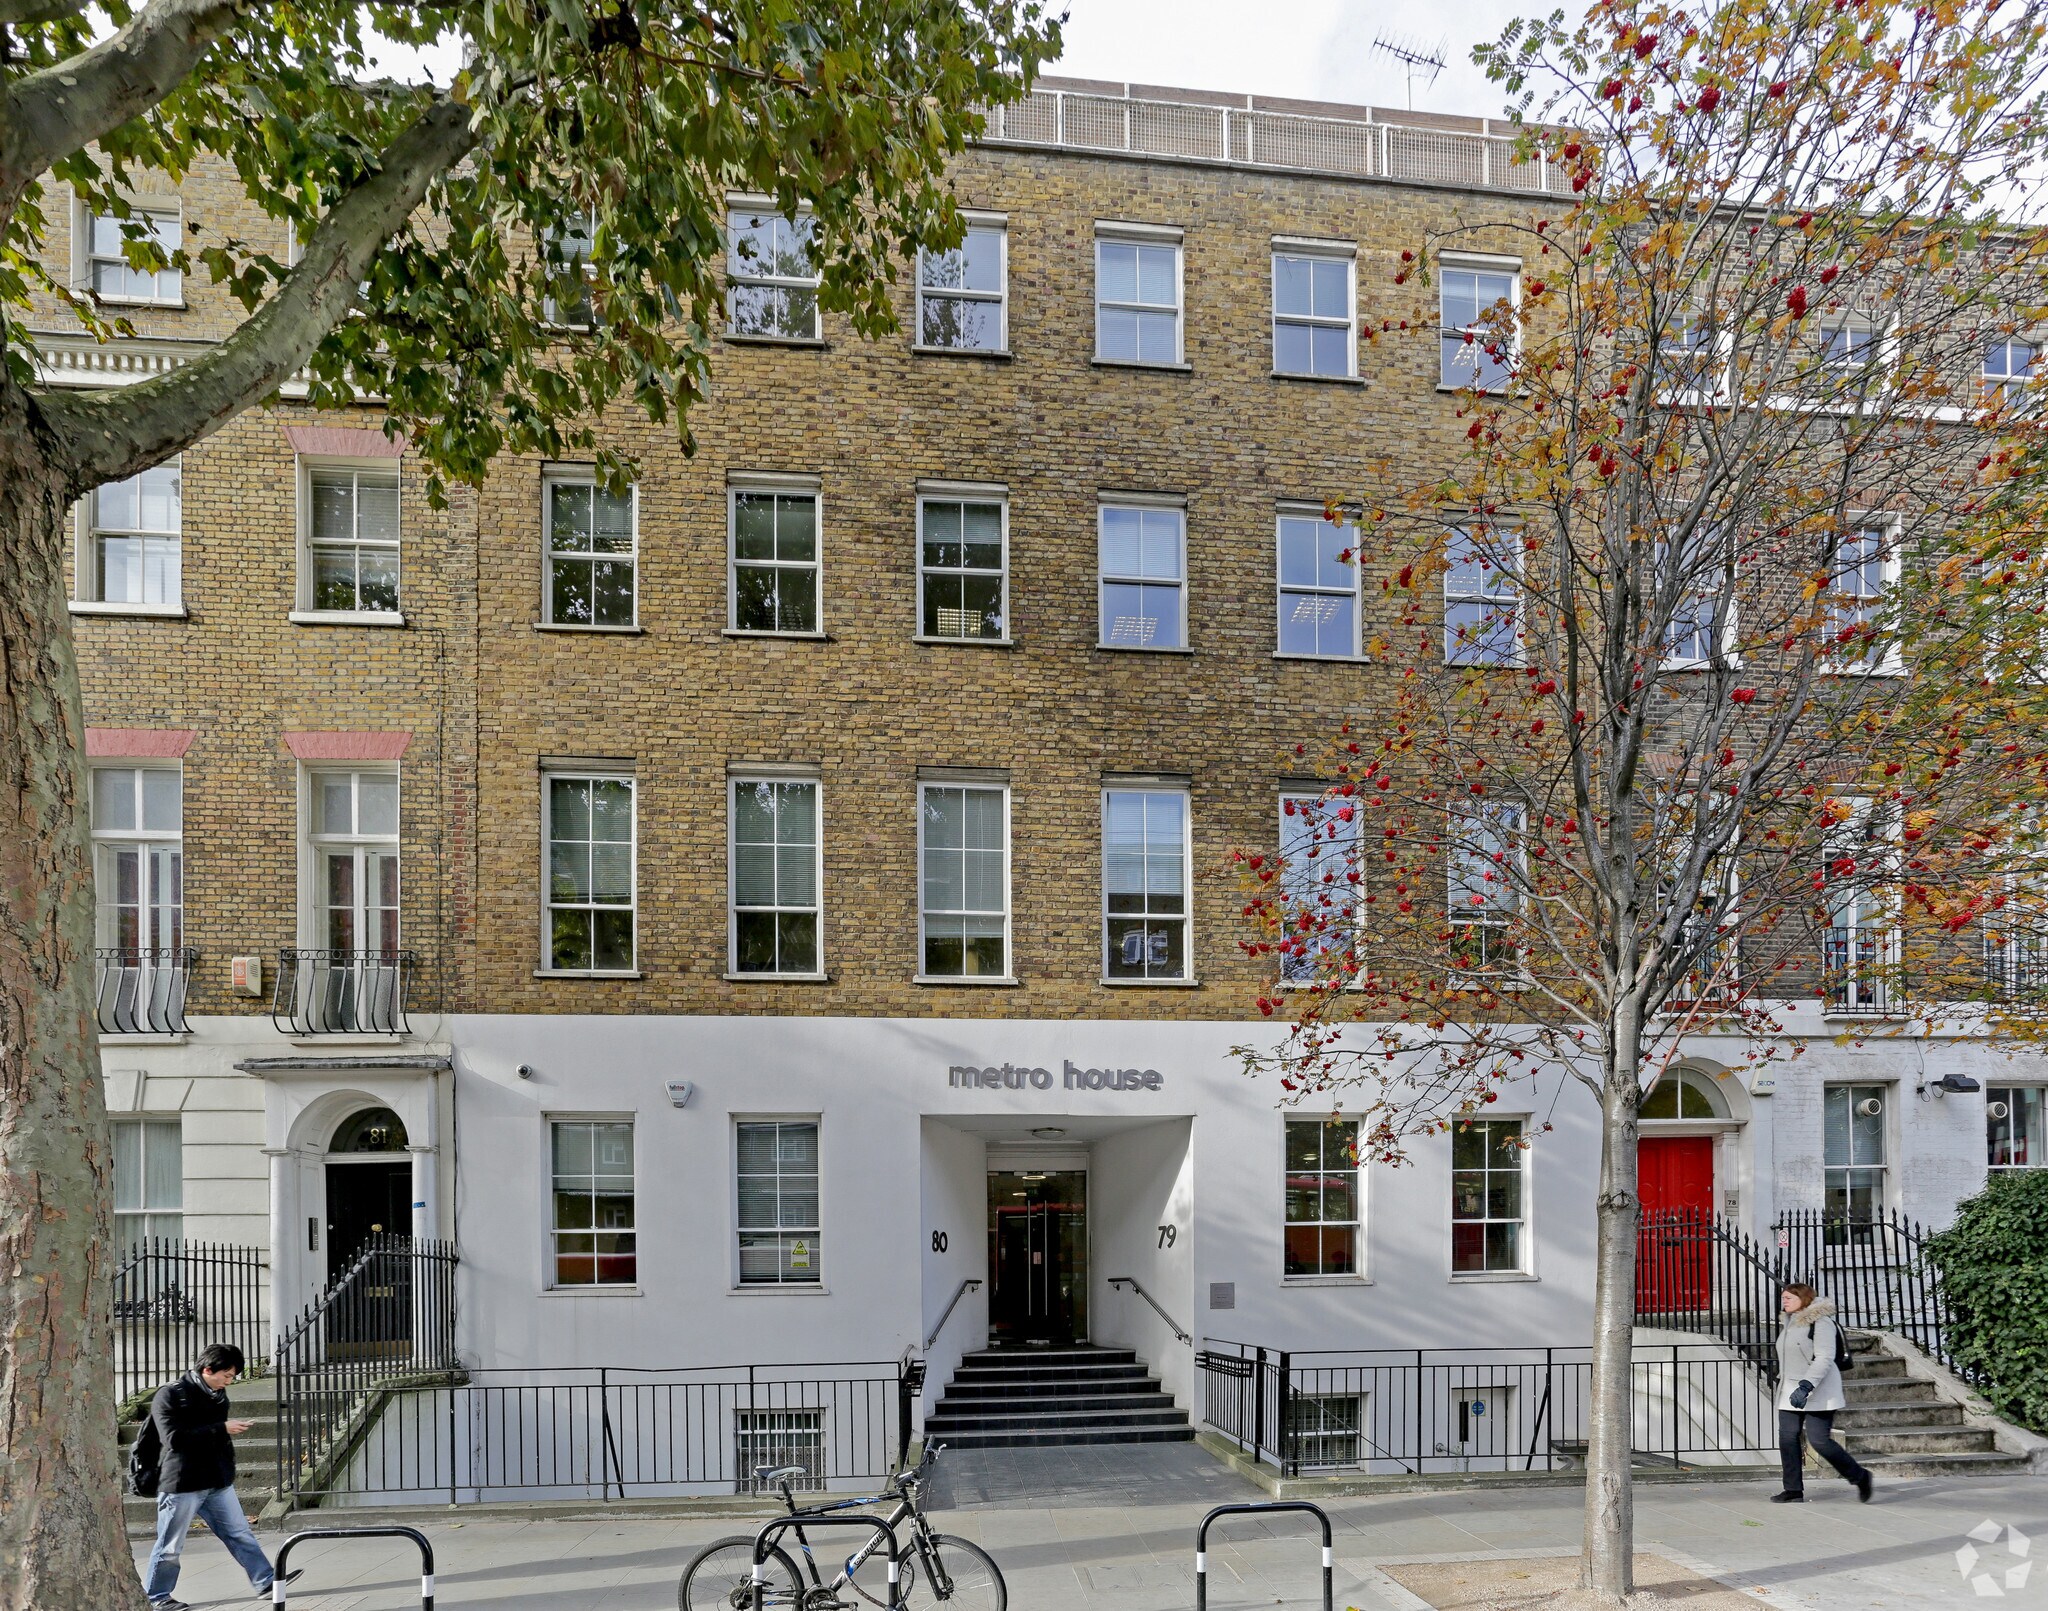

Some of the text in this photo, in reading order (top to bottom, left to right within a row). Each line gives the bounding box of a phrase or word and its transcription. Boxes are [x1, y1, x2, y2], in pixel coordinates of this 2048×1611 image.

[949, 1059, 1163, 1090] metro house
[370, 1128, 386, 1143] 81
[932, 1230, 948, 1253] 80
[1158, 1224, 1176, 1249] 79
